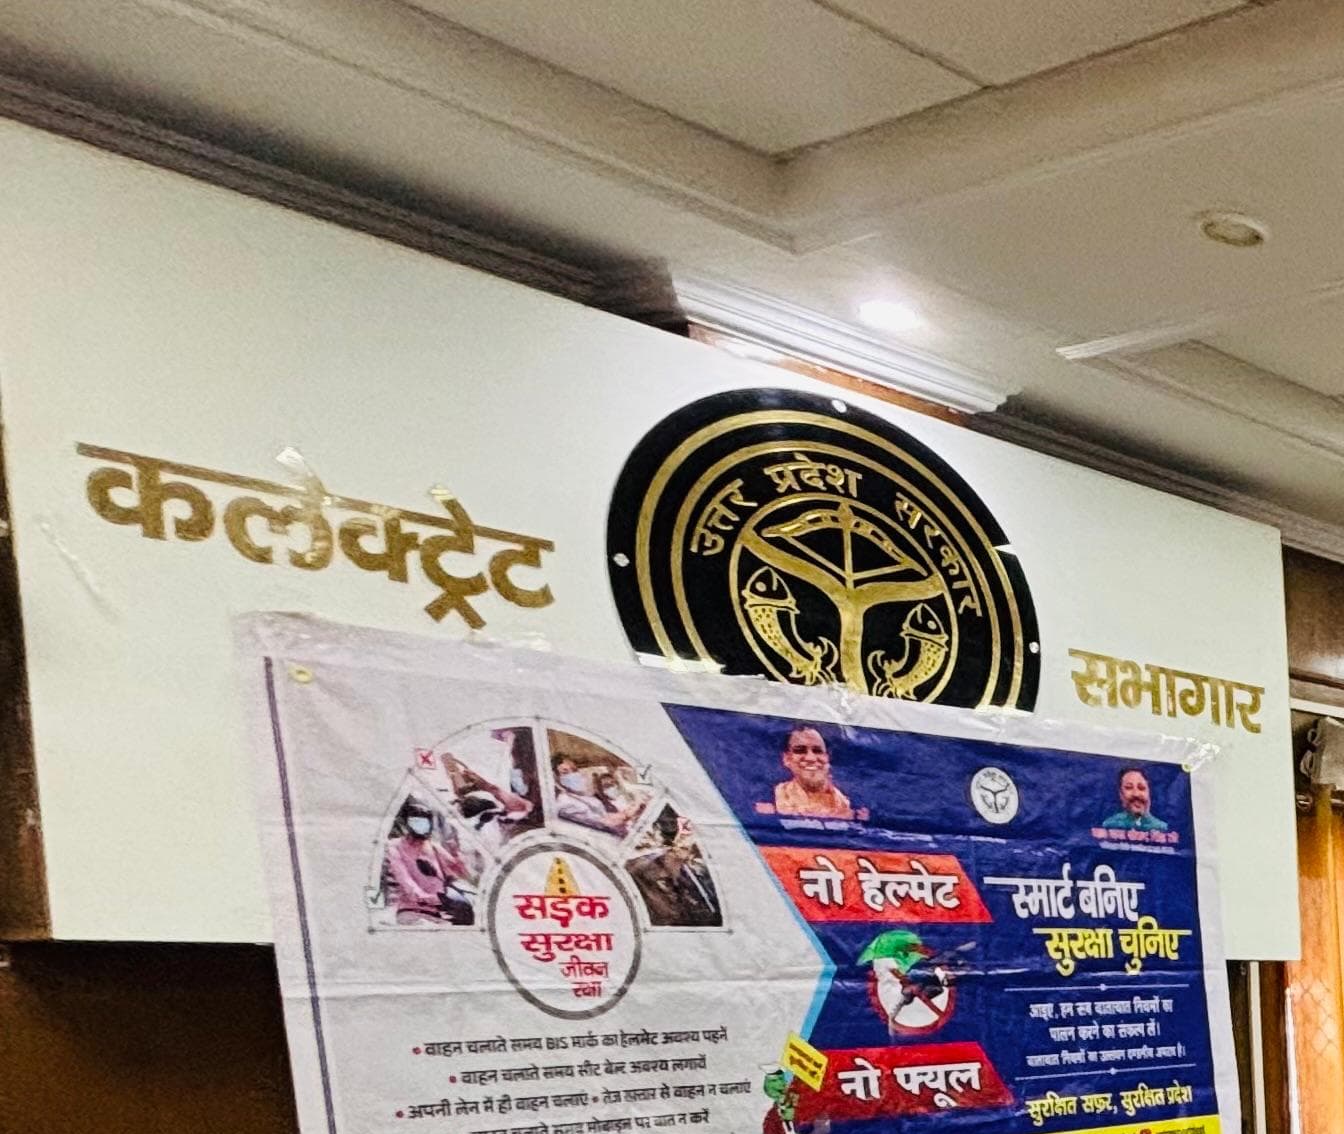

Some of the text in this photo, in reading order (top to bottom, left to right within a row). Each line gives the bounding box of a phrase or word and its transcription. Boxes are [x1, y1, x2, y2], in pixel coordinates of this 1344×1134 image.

[76, 442, 555, 629] कलेक्ट्रेट
[690, 453, 983, 618] उत्तर प्रदेश सरकार
[1068, 648, 1265, 734] सभागार
[799, 856, 960, 912] नो हेल्मेट
[983, 862, 1145, 921] स्मार्ट बनिए
[513, 893, 611, 928] सड़क
[518, 933, 614, 962] सुरक्षा
[1032, 916, 1192, 976] सुरक्षा चुनिए
[558, 954, 609, 978] जीवन
[1160, 999, 1173, 1013] का
[424, 1025, 728, 1057] वाहन चलाते समय BIS मार्क का हेलमेट अवश्य पहनें
[1049, 1026, 1075, 1041] पालन
[1101, 1024, 1115, 1038] का
[461, 1069, 498, 1085] वाहन
[501, 1063, 540, 1082] चलाते
[542, 1065, 575, 1079] समय
[577, 1059, 601, 1077] सीट
[629, 1060, 669, 1074] अवश्य
[837, 1057, 881, 1100] नो
[893, 1062, 982, 1108] फ्यूल
[408, 1098, 451, 1119] अपनी
[454, 1096, 480, 1115] लेन
[483, 1095, 494, 1113] में
[496, 1094, 512, 1114] ही
[514, 1096, 549, 1111] वाहन
[601, 1087, 621, 1104] तेज
[657, 1082, 671, 1100] से
[672, 1085, 705, 1099] वाहन
[707, 1084, 716, 1096] न
[1025, 1091, 1077, 1126] सुरक्षित
[1120, 1082, 1165, 1117] सुरक्षित
[1166, 1080, 1193, 1104] प्रदेश
[634, 1117, 650, 1129] पर
[677, 1114, 686, 1124] न
